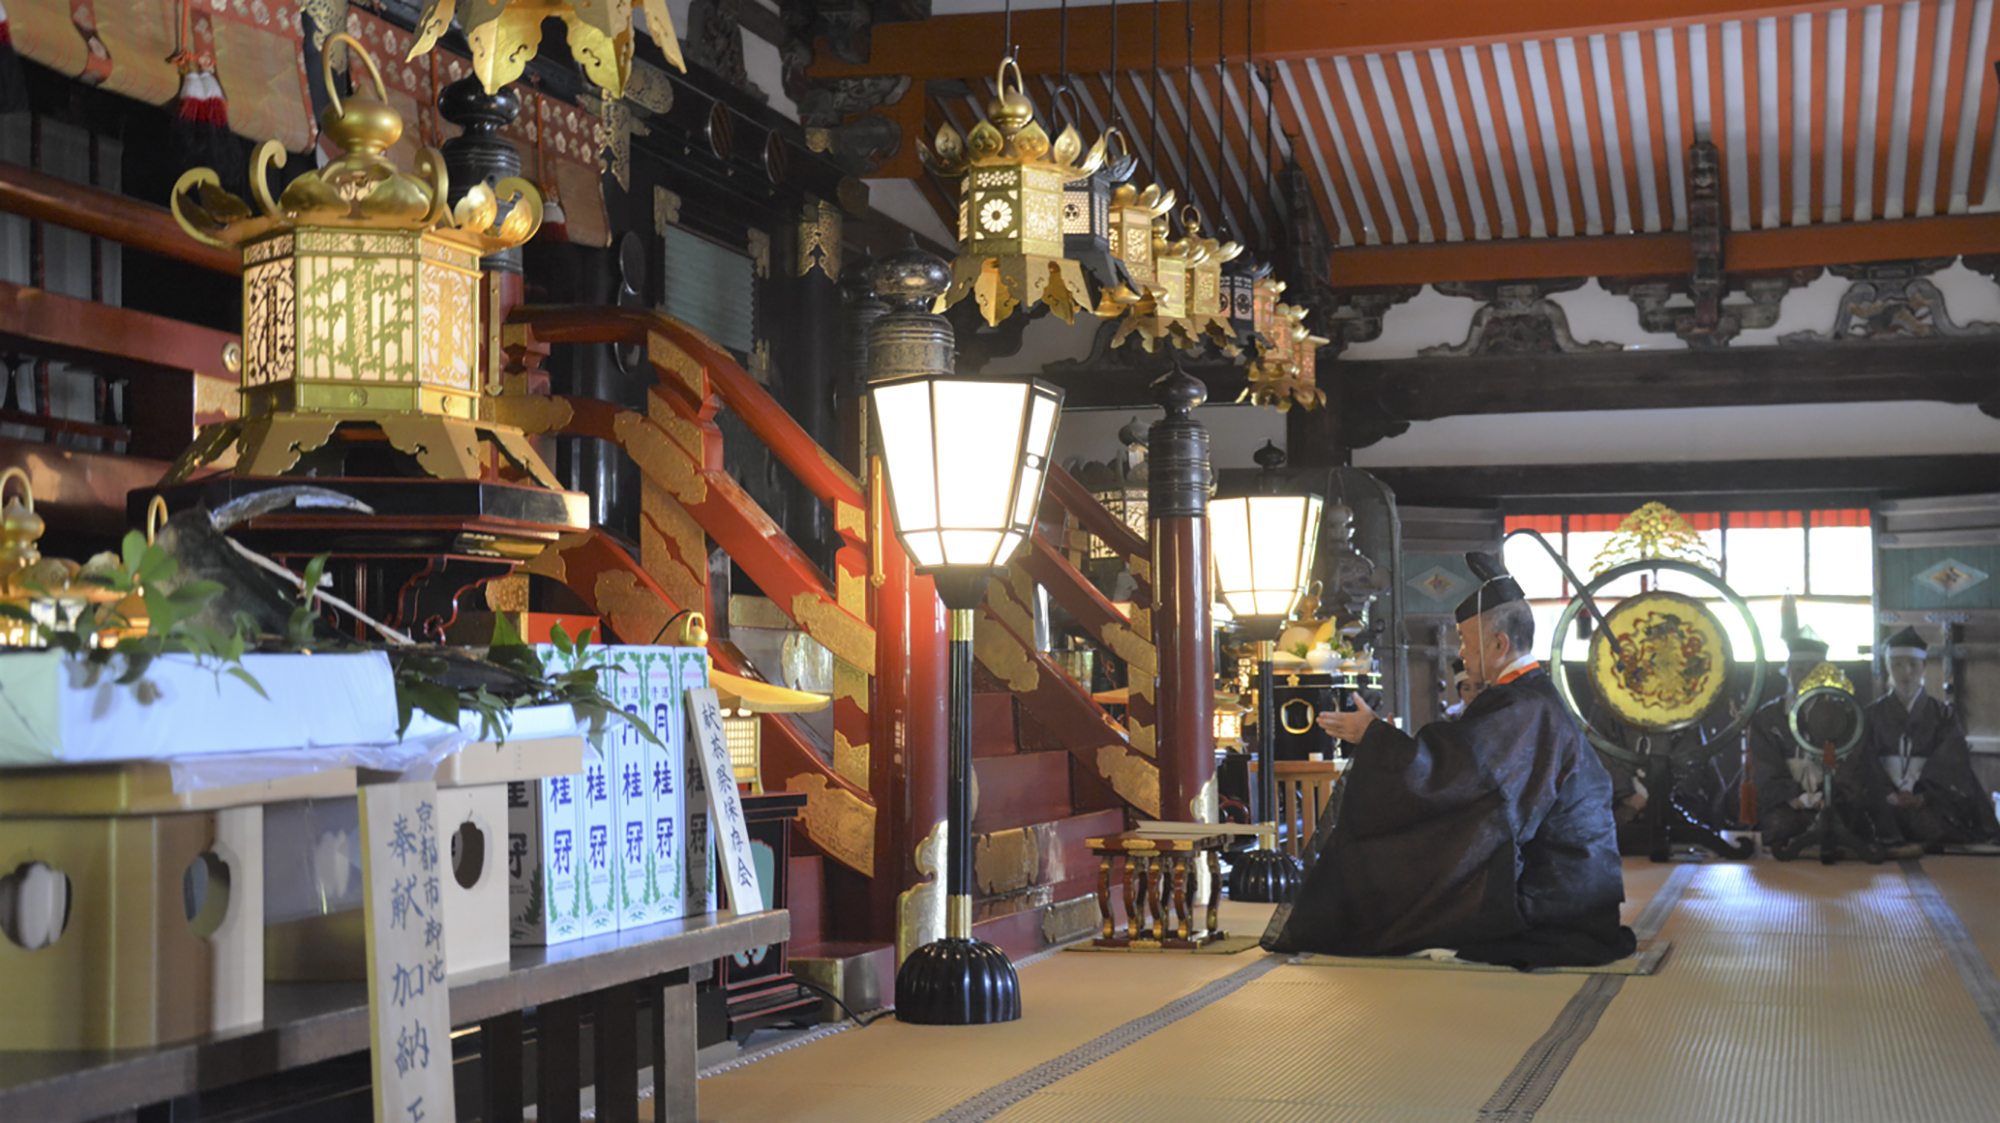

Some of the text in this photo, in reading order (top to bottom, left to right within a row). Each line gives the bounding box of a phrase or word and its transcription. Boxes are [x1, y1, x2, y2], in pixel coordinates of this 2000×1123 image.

[585, 738, 607, 869] 桂冠
[621, 703, 644, 864] 月桂冠
[652, 703, 674, 859] 月桂冠
[686, 720, 706, 854] 桂冠
[416, 800, 445, 985] 京都市御池
